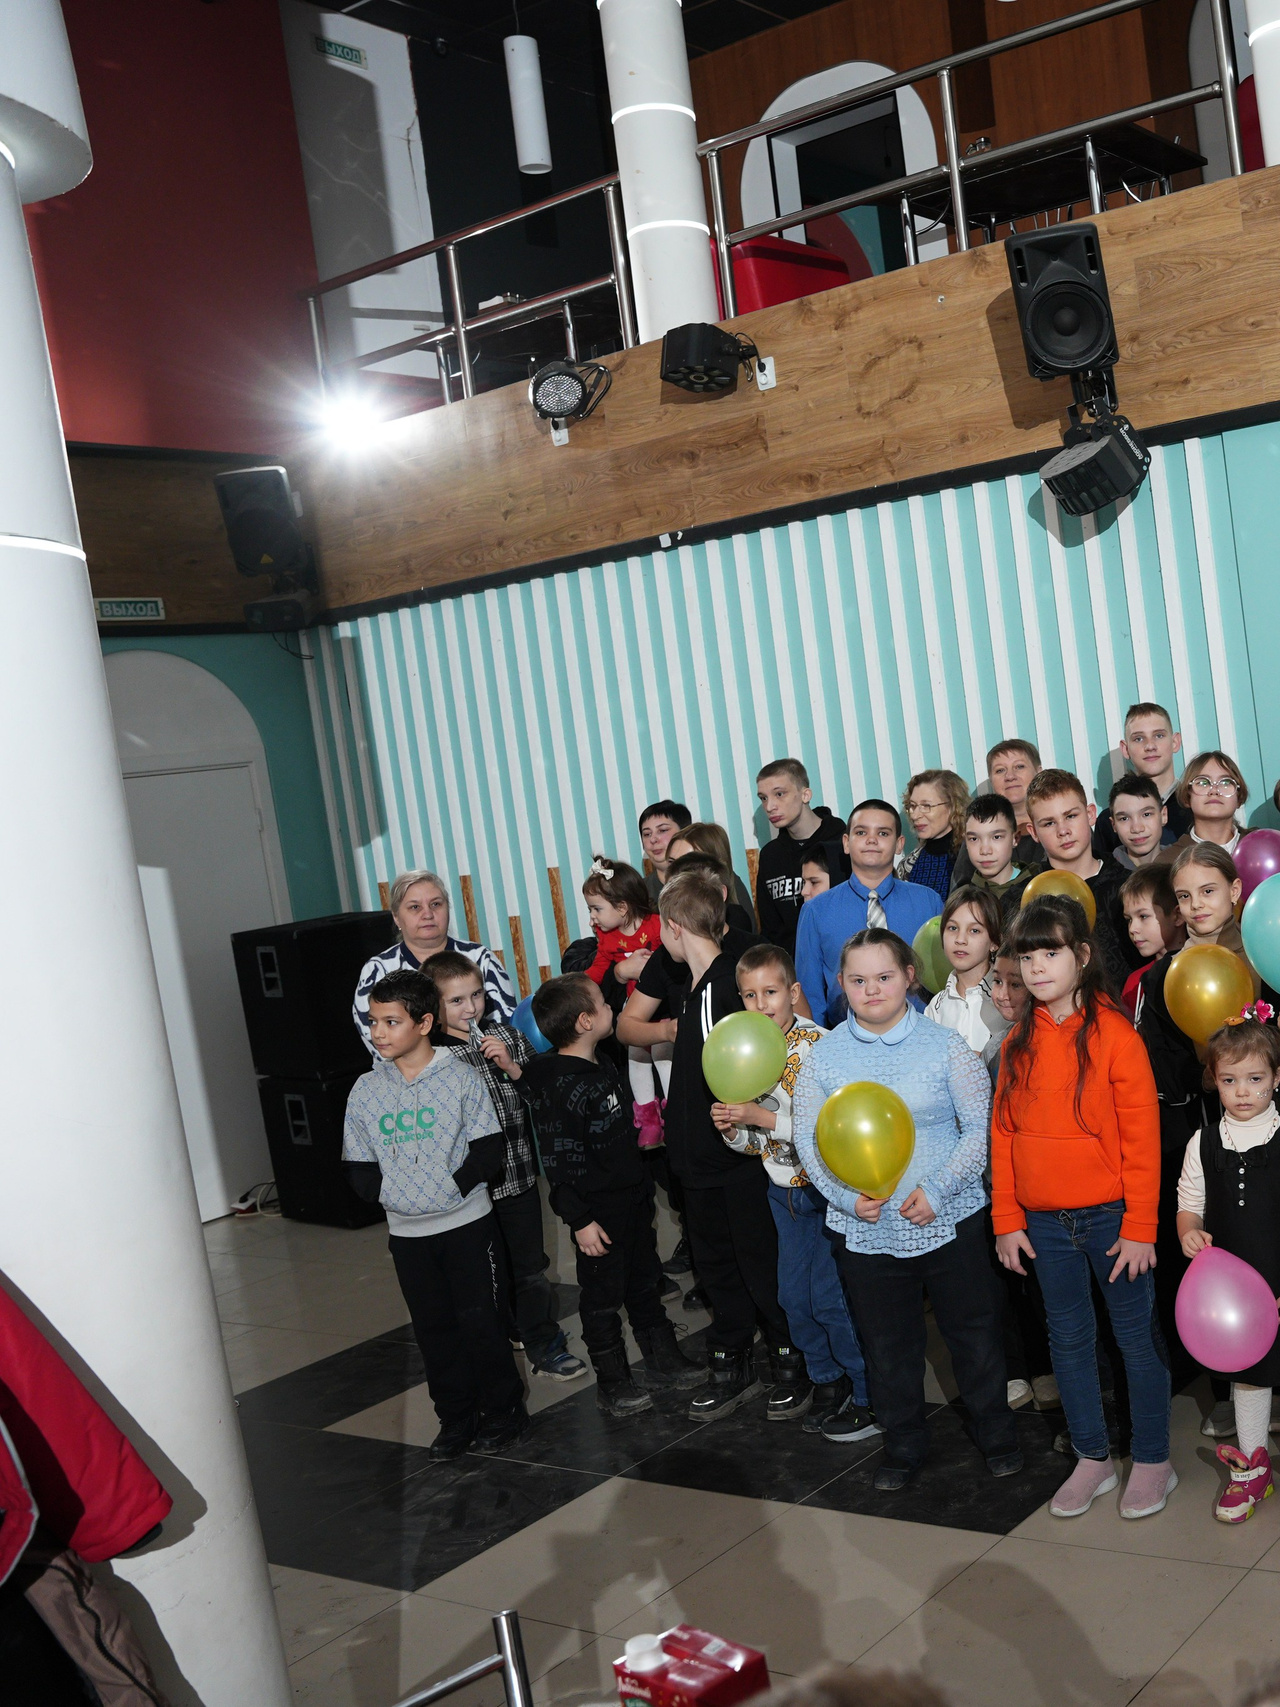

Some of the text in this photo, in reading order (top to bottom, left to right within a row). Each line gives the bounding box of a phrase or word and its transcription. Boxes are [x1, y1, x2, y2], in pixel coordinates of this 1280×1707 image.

[101, 603, 158, 616] ВЫХОД
[379, 1107, 435, 1136] CCC
[541, 1155, 557, 1167] SG
